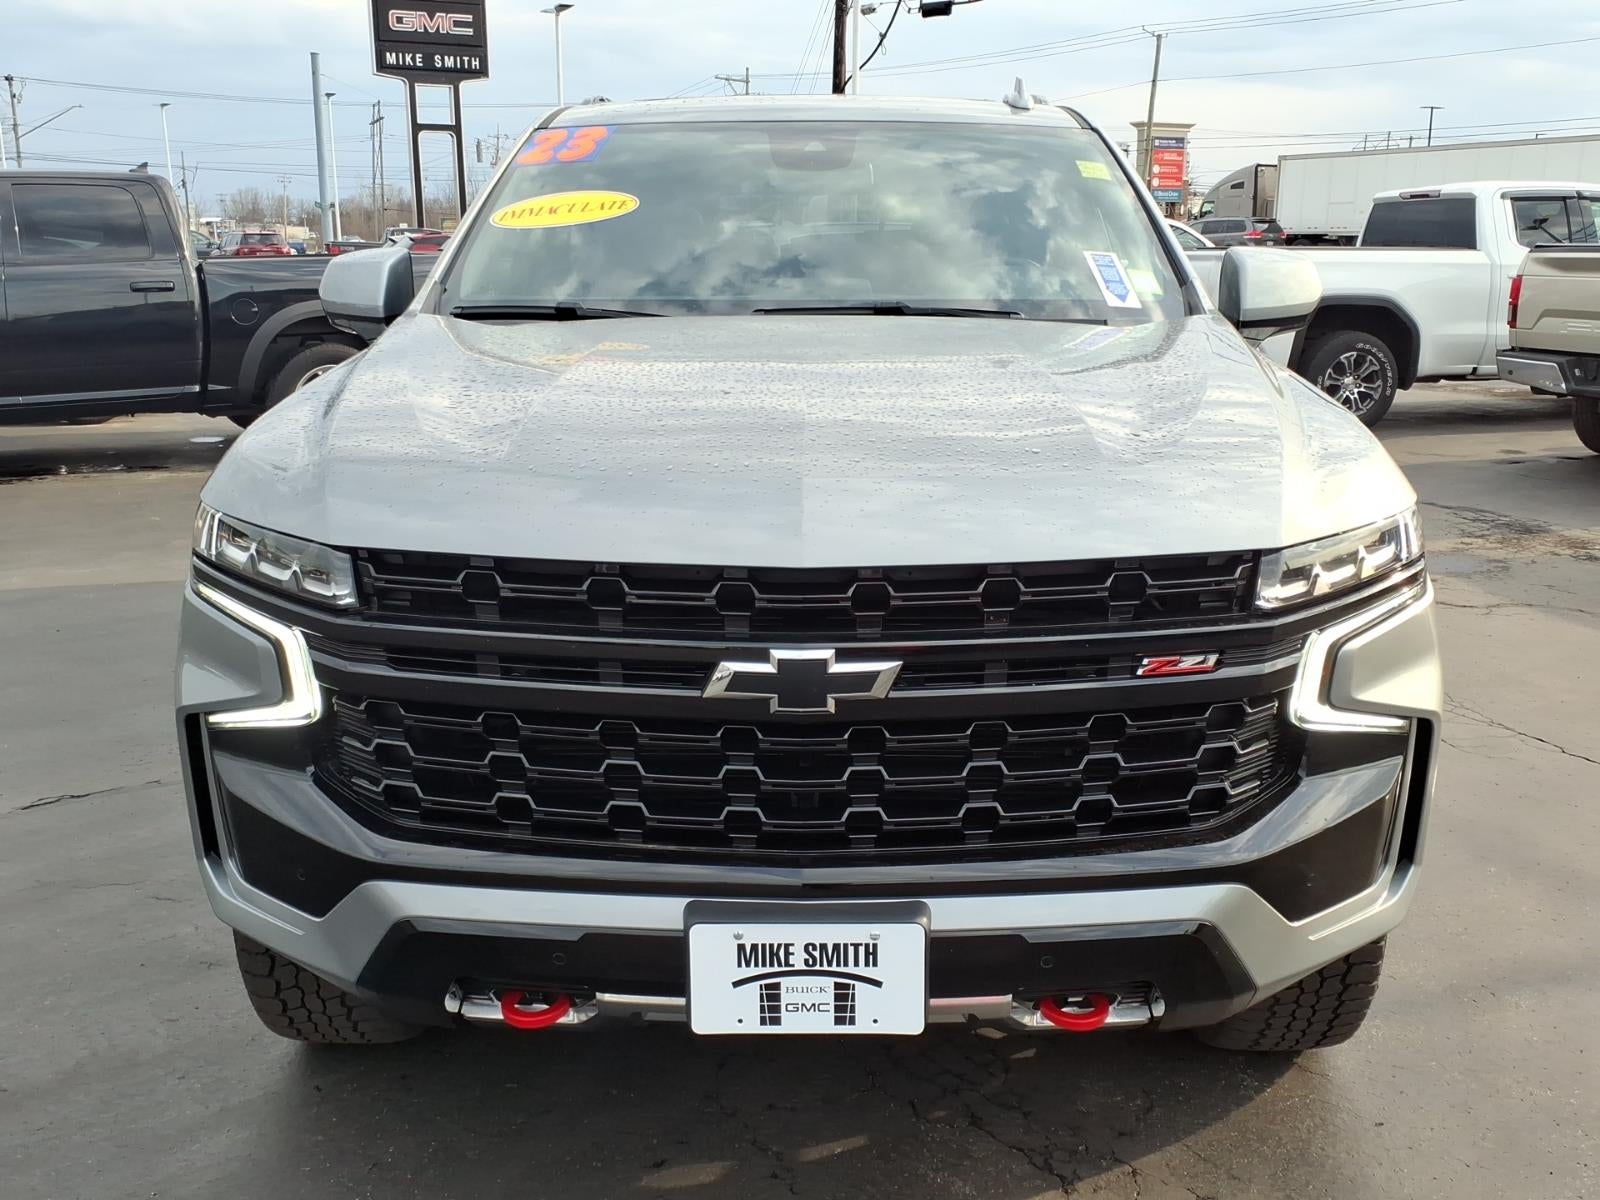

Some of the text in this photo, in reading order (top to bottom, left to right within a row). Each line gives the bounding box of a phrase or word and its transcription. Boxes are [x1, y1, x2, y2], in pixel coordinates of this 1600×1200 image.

[388, 9, 474, 36] GMC
[386, 51, 480, 70] MIKE SMITH
[516, 126, 609, 165] 23
[499, 199, 633, 222] IMMACULATE
[1136, 653, 1220, 677] Z71
[736, 942, 879, 969] MIKE SMITH
[785, 985, 828, 994] BUICK
[785, 1002, 831, 1013] GMC
